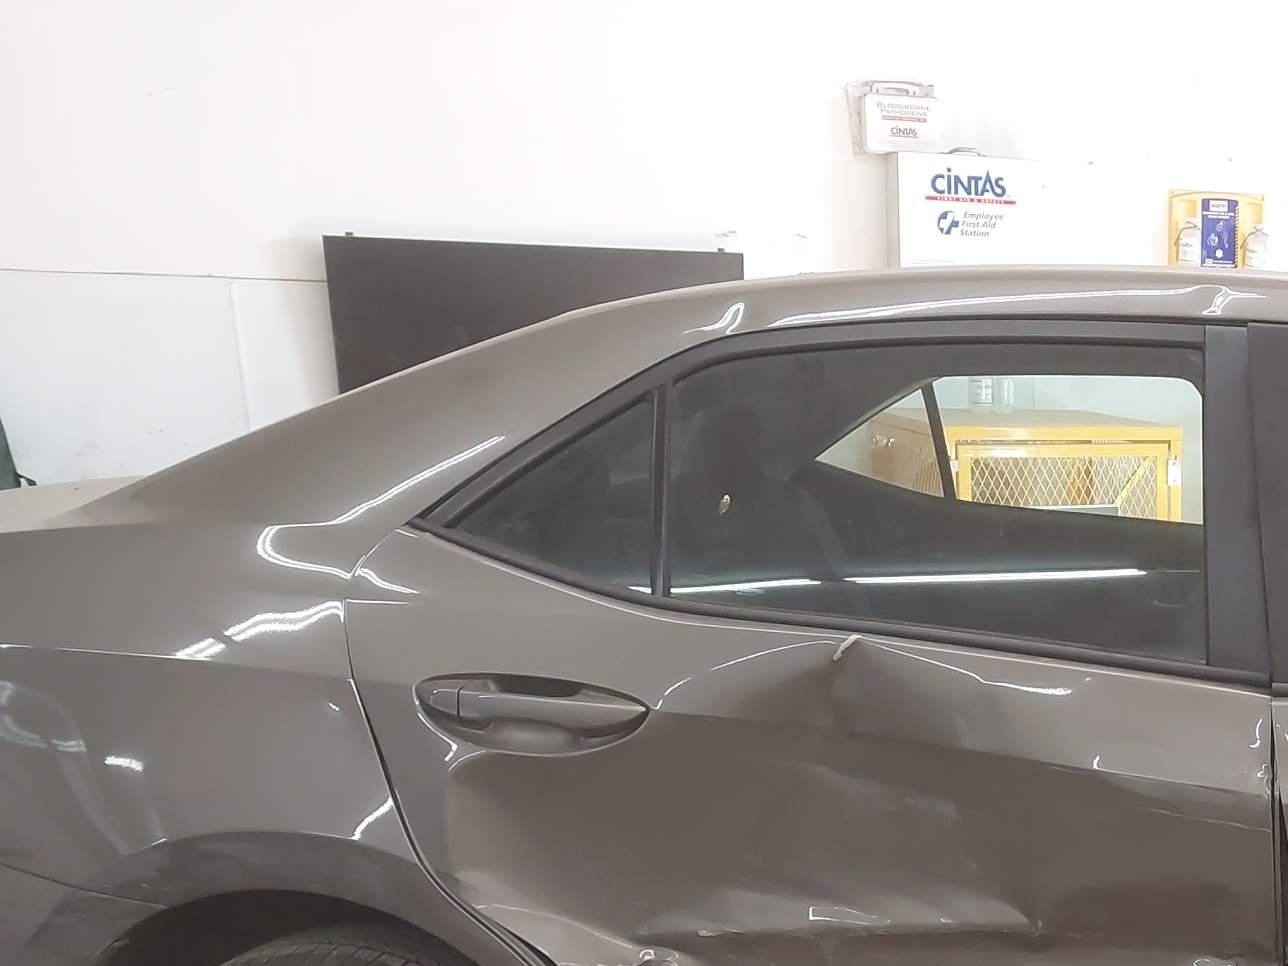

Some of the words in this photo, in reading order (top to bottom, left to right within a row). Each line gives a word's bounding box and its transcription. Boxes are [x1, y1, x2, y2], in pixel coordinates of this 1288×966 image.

[963, 211, 1004, 221] Employee
[981, 221, 997, 229] Aid
[960, 229, 990, 237] Station
